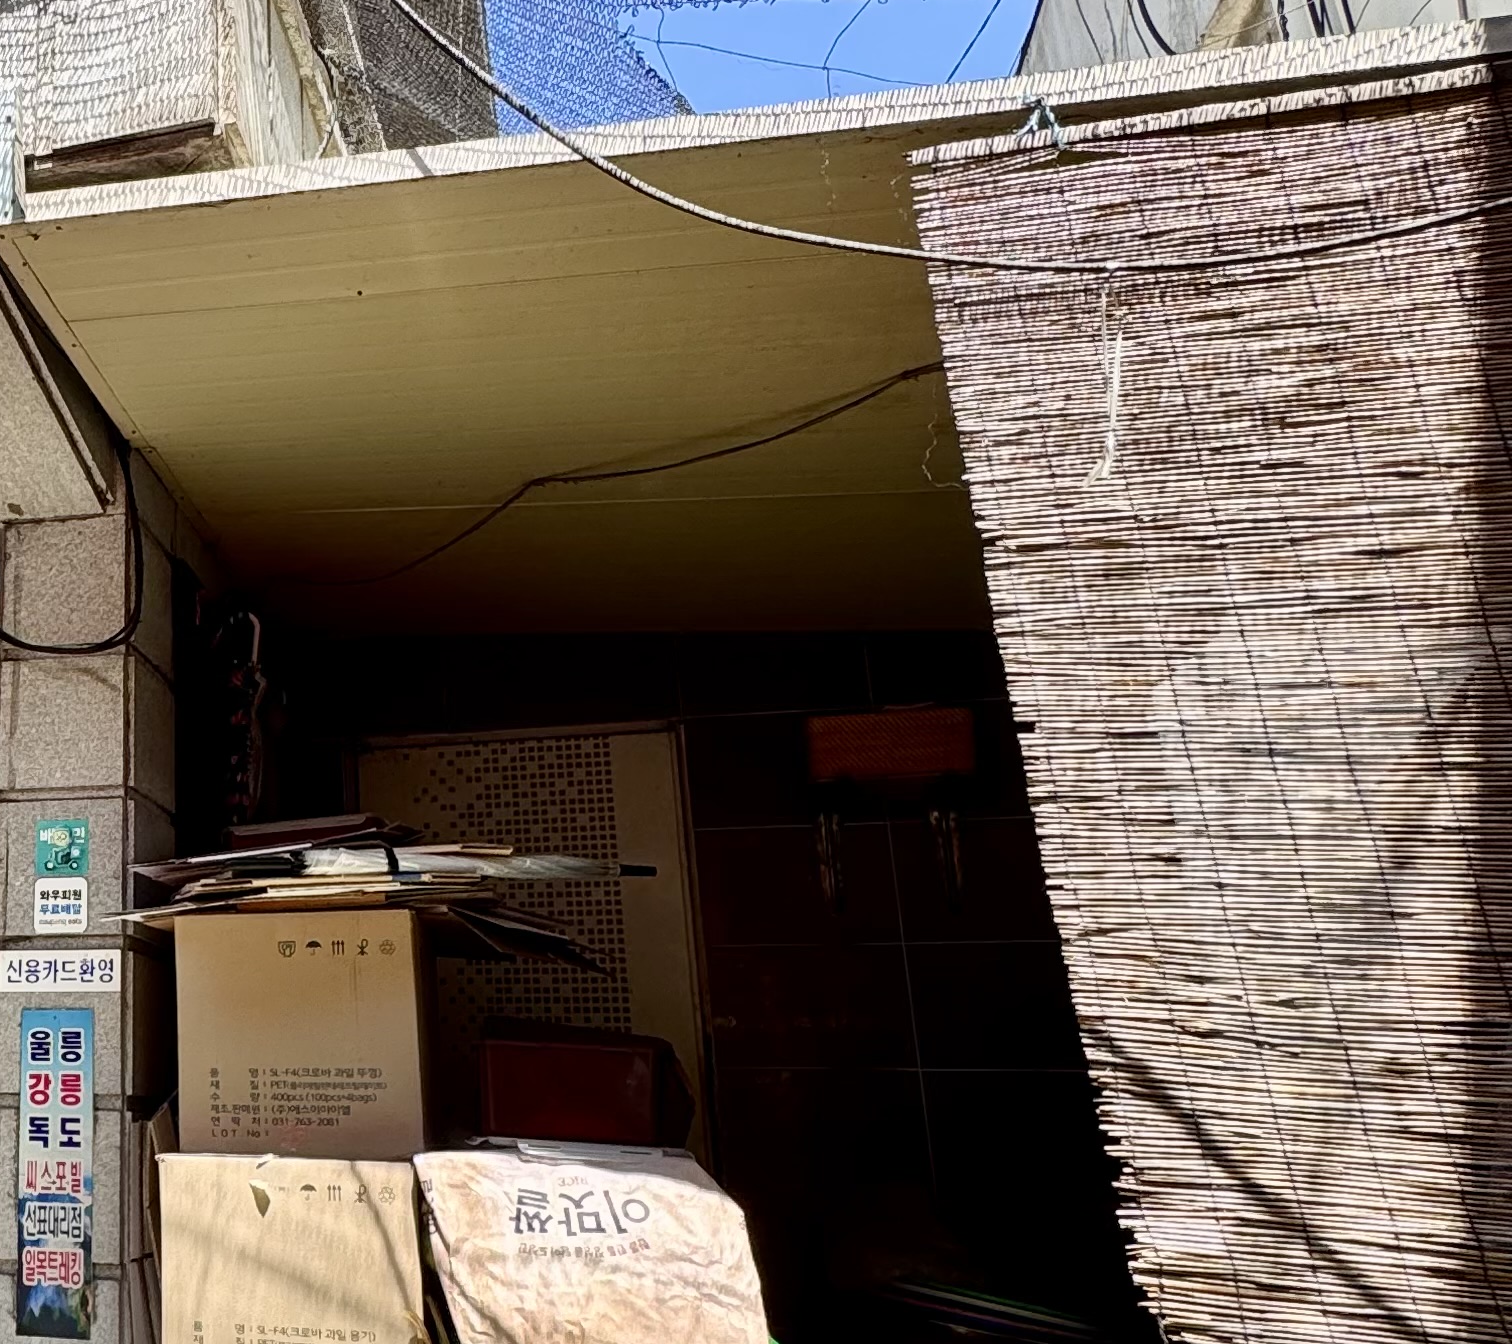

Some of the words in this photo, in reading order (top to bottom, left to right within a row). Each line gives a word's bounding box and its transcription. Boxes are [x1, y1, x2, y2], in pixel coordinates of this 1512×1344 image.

[39, 903, 82, 916] 무료배달
[5, 957, 114, 984] 신용카드환영
[29, 1030, 83, 1063] 울릉
[28, 1073, 82, 1107] 강릉
[28, 1116, 82, 1149] 독도
[509, 1188, 651, 1237] 이맛쌀
